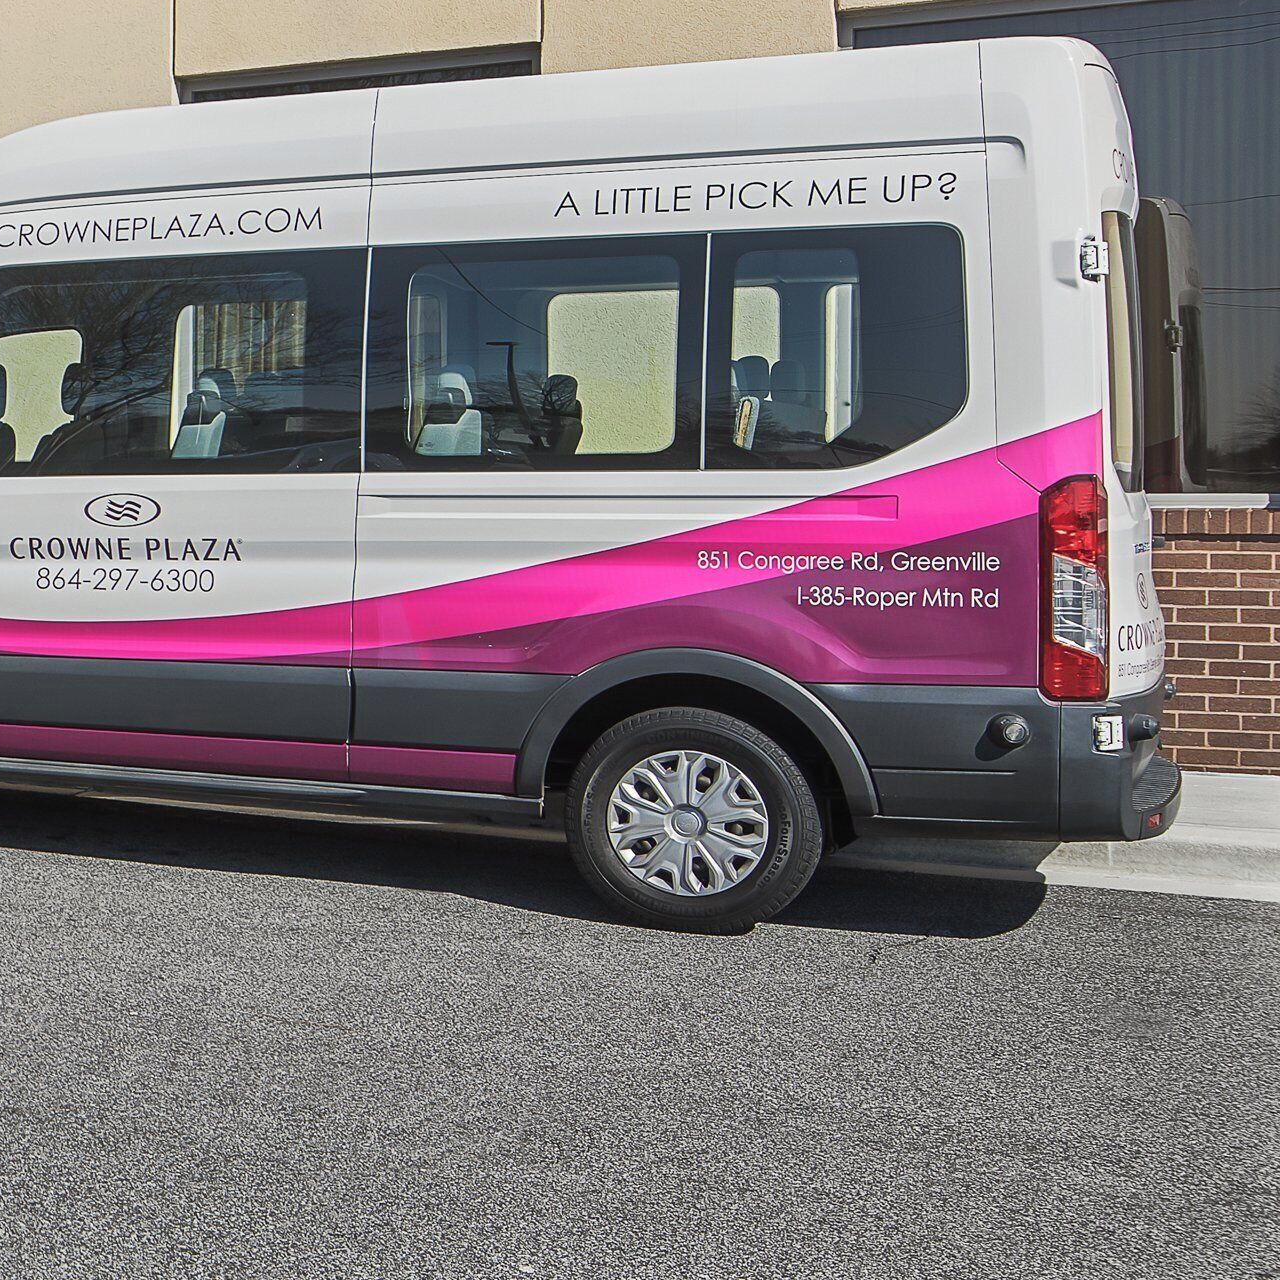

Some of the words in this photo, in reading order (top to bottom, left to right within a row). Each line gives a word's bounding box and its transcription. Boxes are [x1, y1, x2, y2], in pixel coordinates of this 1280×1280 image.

[553, 191, 581, 218] A
[594, 185, 692, 216] LITTLE
[705, 179, 794, 211] PICK
[806, 176, 869, 207] ME
[882, 172, 958, 203] UP?
[9, 537, 132, 561] CROWNE
[696, 550, 730, 570] 851
[737, 551, 845, 575] Congaree
[850, 551, 884, 572] Rd,
[890, 551, 1001, 572] Greenville
[35, 566, 216, 593] 864-297-6300
[796, 585, 918, 611] I-385-Roper
[921, 587, 965, 609] Mtn
[970, 588, 1000, 609] Rd
